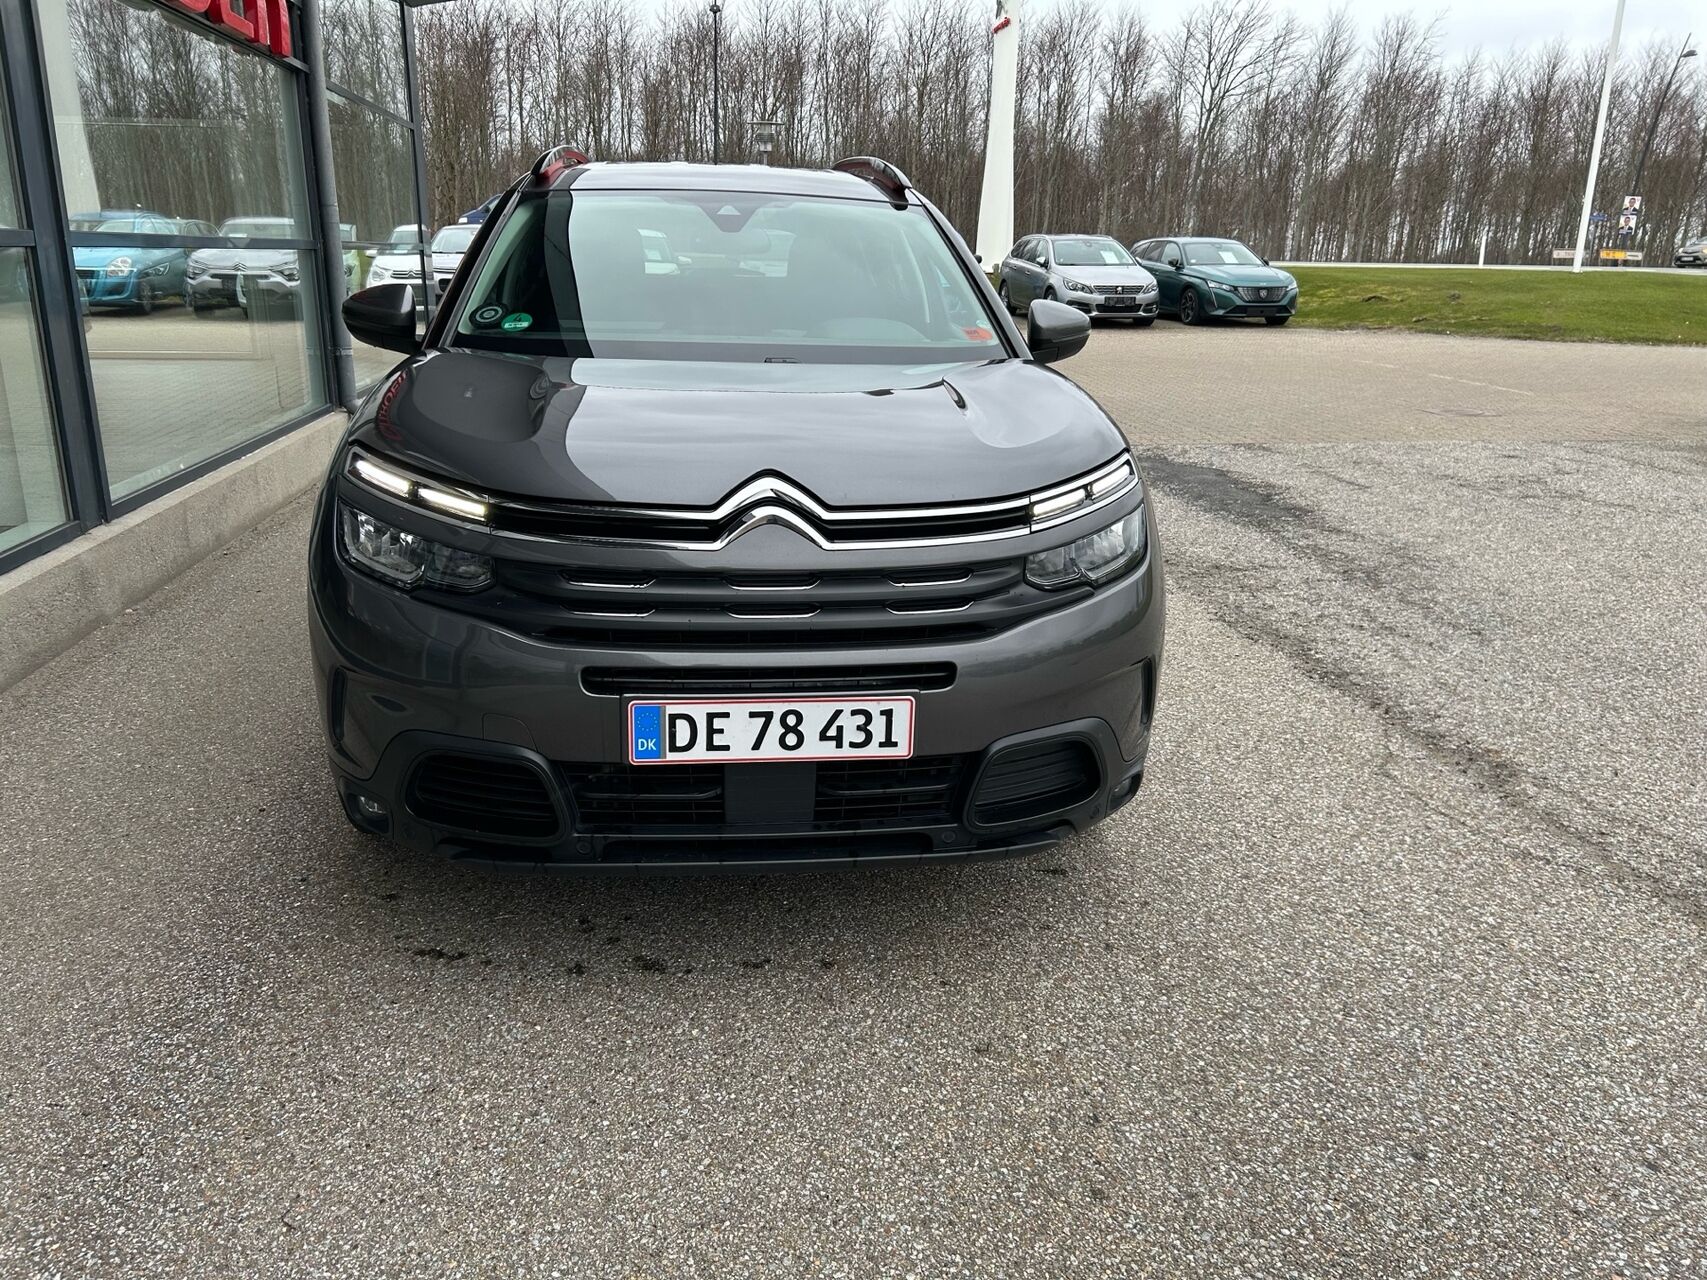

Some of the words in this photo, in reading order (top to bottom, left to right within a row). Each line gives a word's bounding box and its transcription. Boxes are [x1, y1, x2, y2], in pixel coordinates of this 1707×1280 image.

[668, 712, 731, 753] DE
[749, 709, 805, 751] 78
[819, 708, 899, 750] 431
[638, 739, 656, 751] DK
